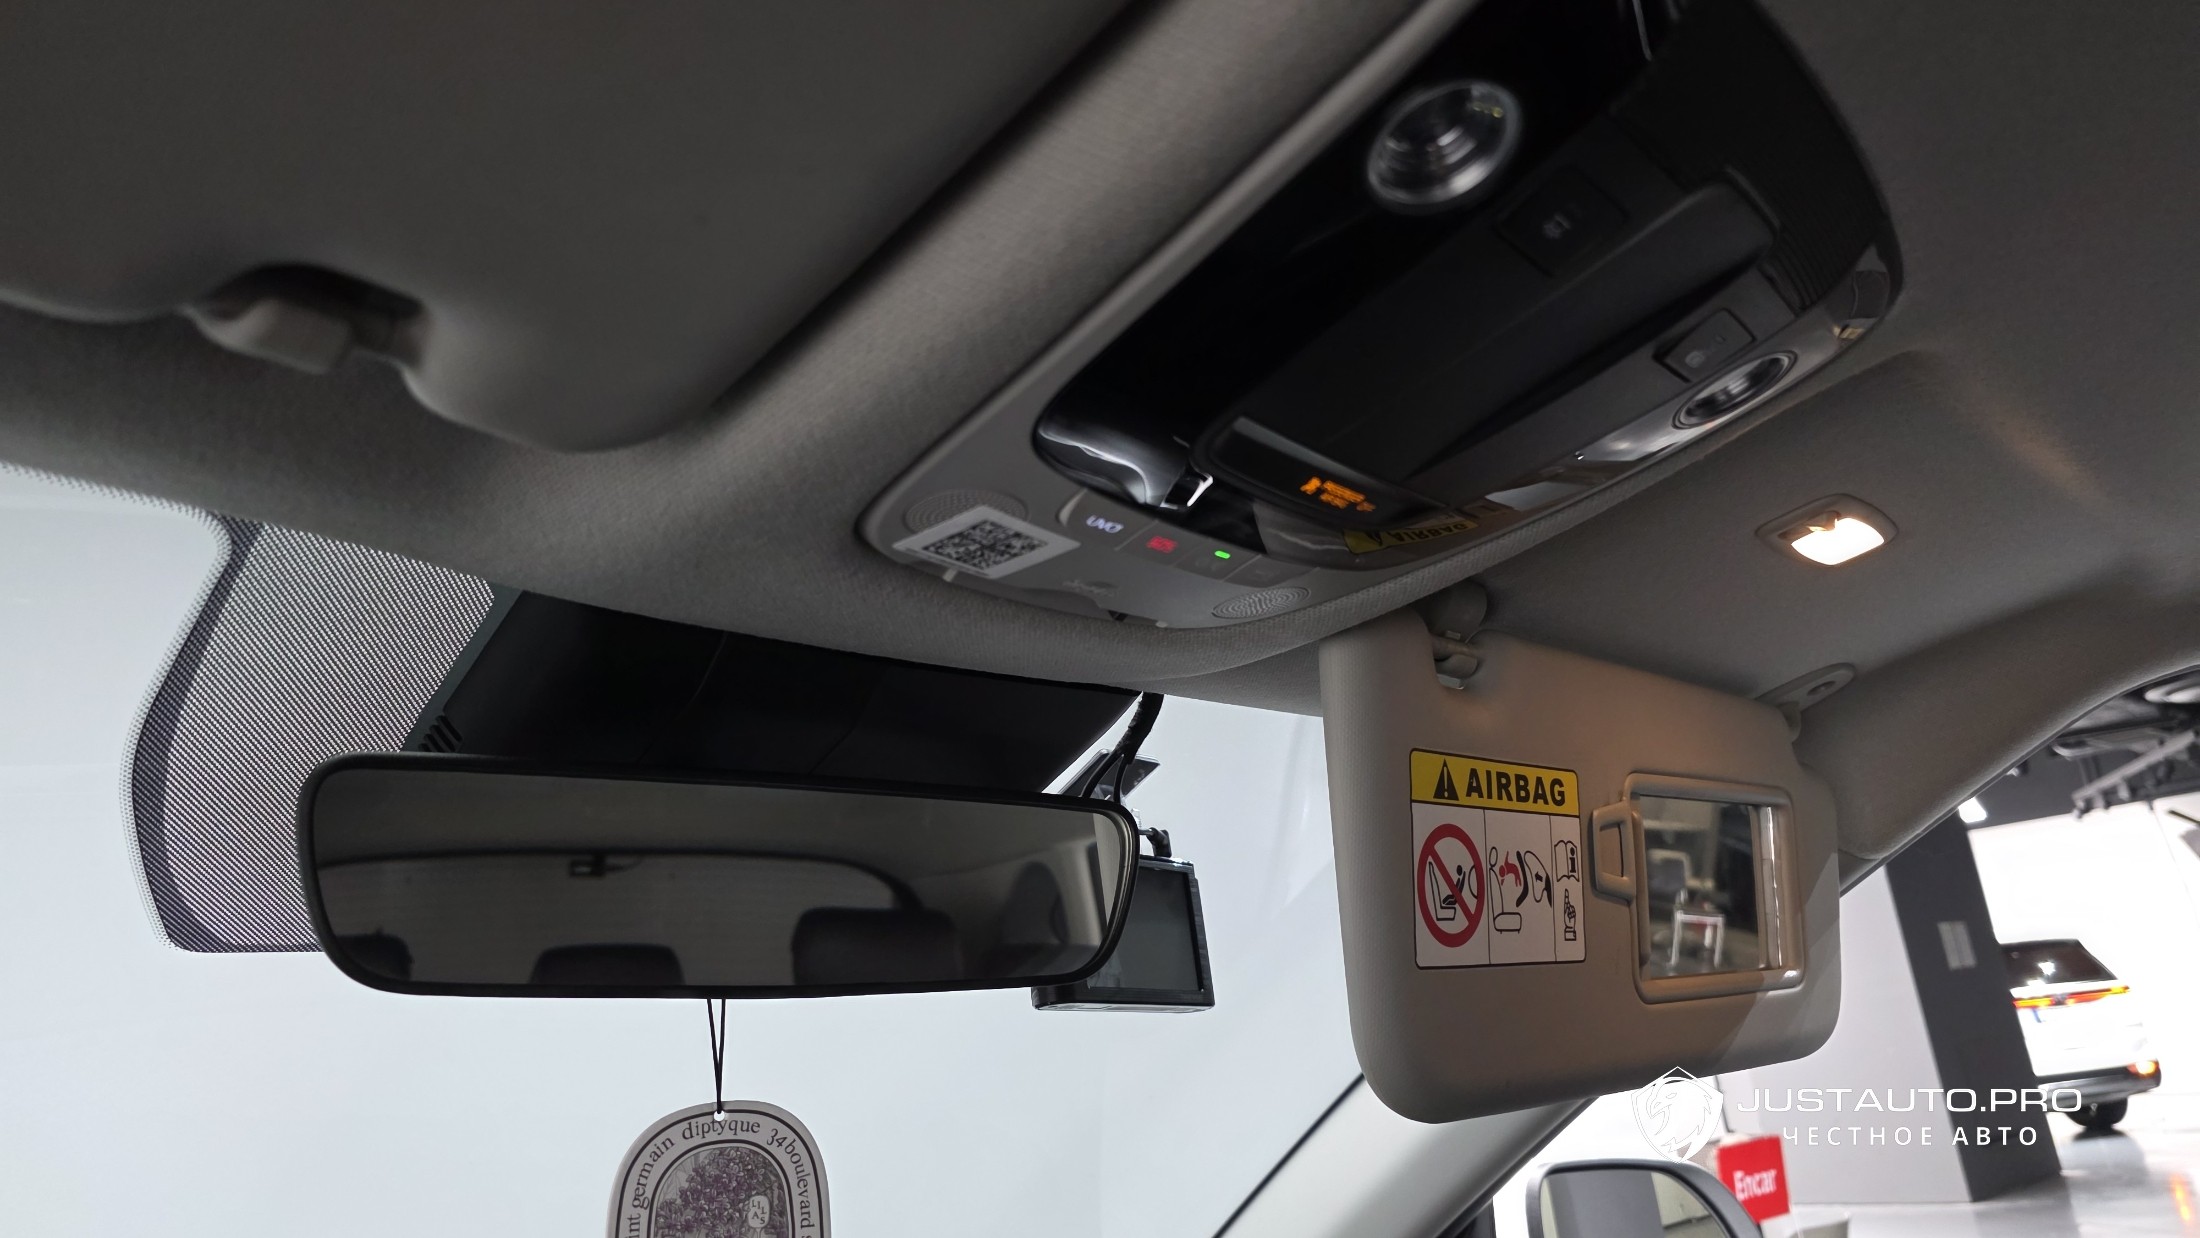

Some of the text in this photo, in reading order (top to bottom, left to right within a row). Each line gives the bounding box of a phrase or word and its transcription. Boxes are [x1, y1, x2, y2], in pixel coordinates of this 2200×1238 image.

[1465, 767, 1566, 807] AIRBAG
[632, 1137, 676, 1210] germain
[682, 1118, 761, 1140] diptyque
[1733, 1169, 1778, 1202] Encar
